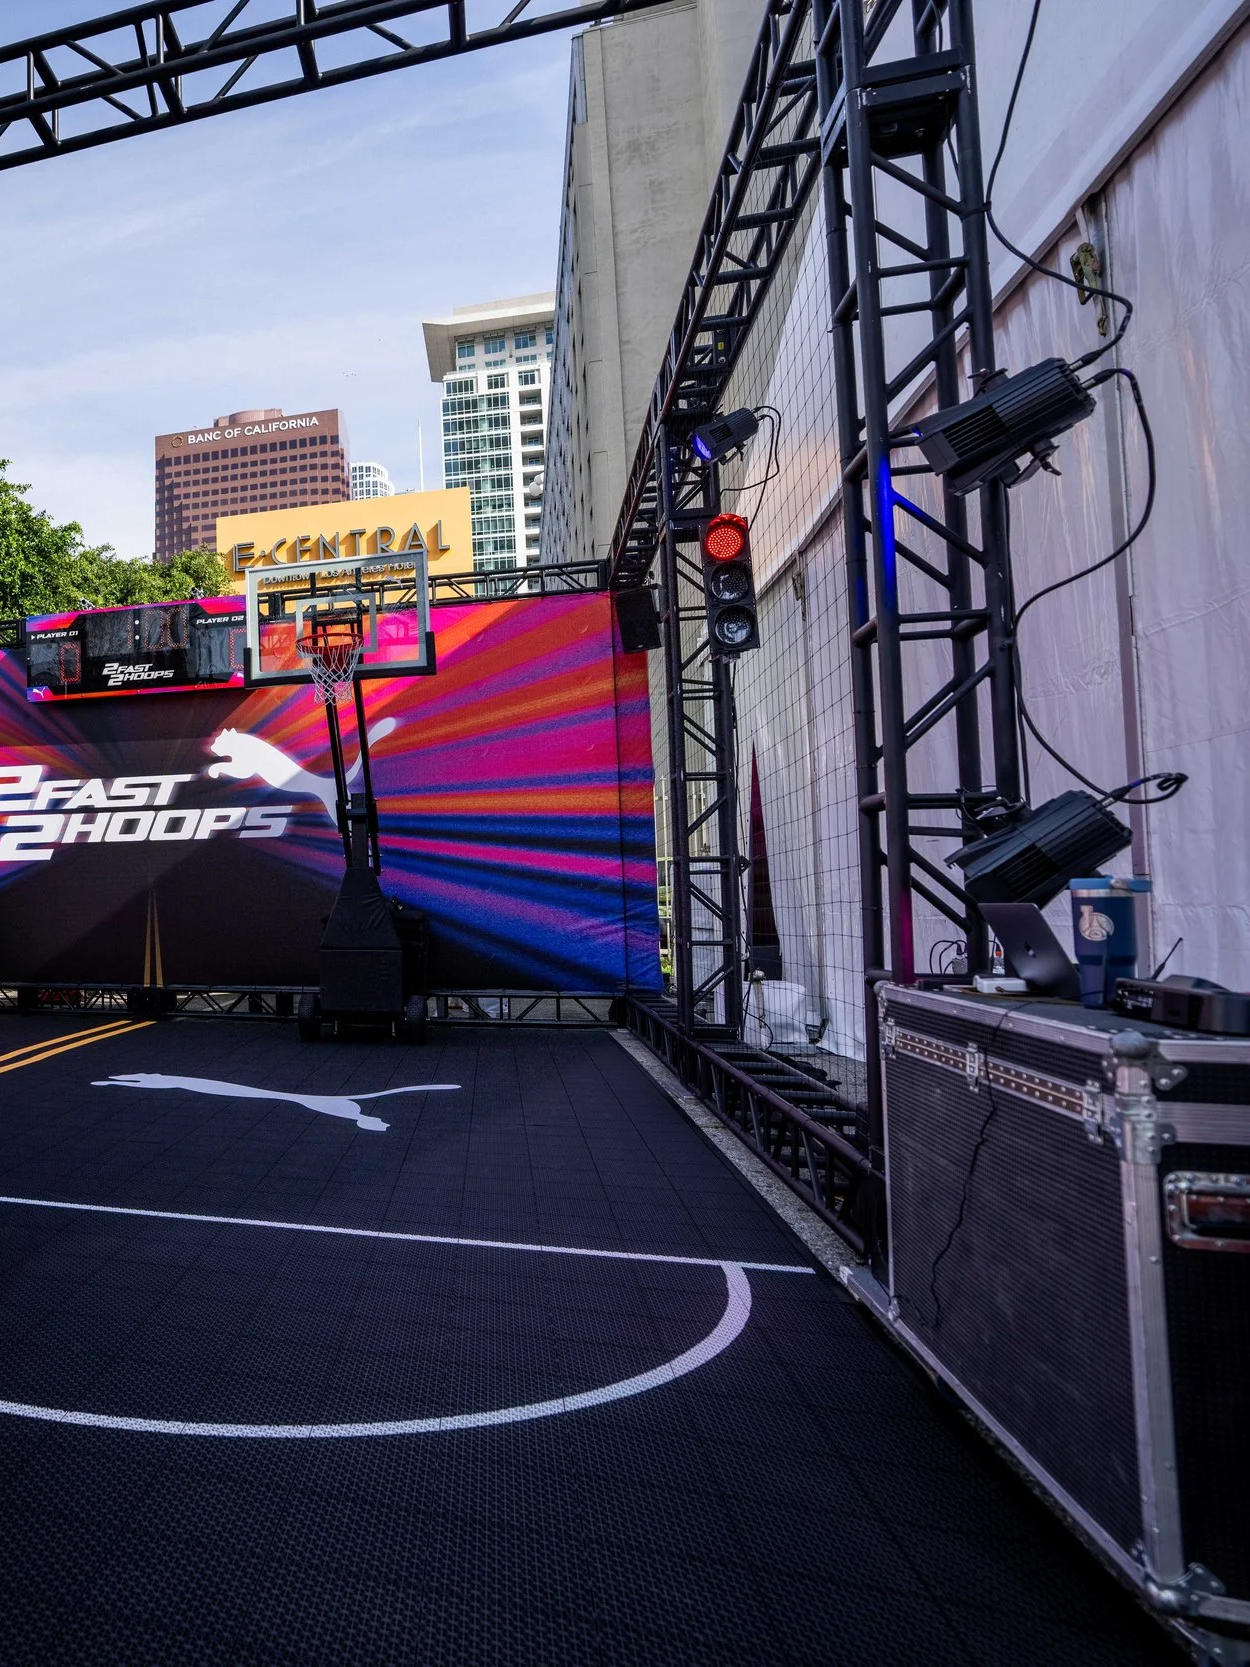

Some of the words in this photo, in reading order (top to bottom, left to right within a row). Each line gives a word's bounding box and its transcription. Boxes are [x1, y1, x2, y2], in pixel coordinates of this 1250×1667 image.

[188, 432, 222, 444] BANC
[224, 428, 241, 439] OF
[244, 416, 319, 436] CALIFORNIA
[196, 616, 229, 624] PLAYER
[36, 631, 67, 639] PLAYER
